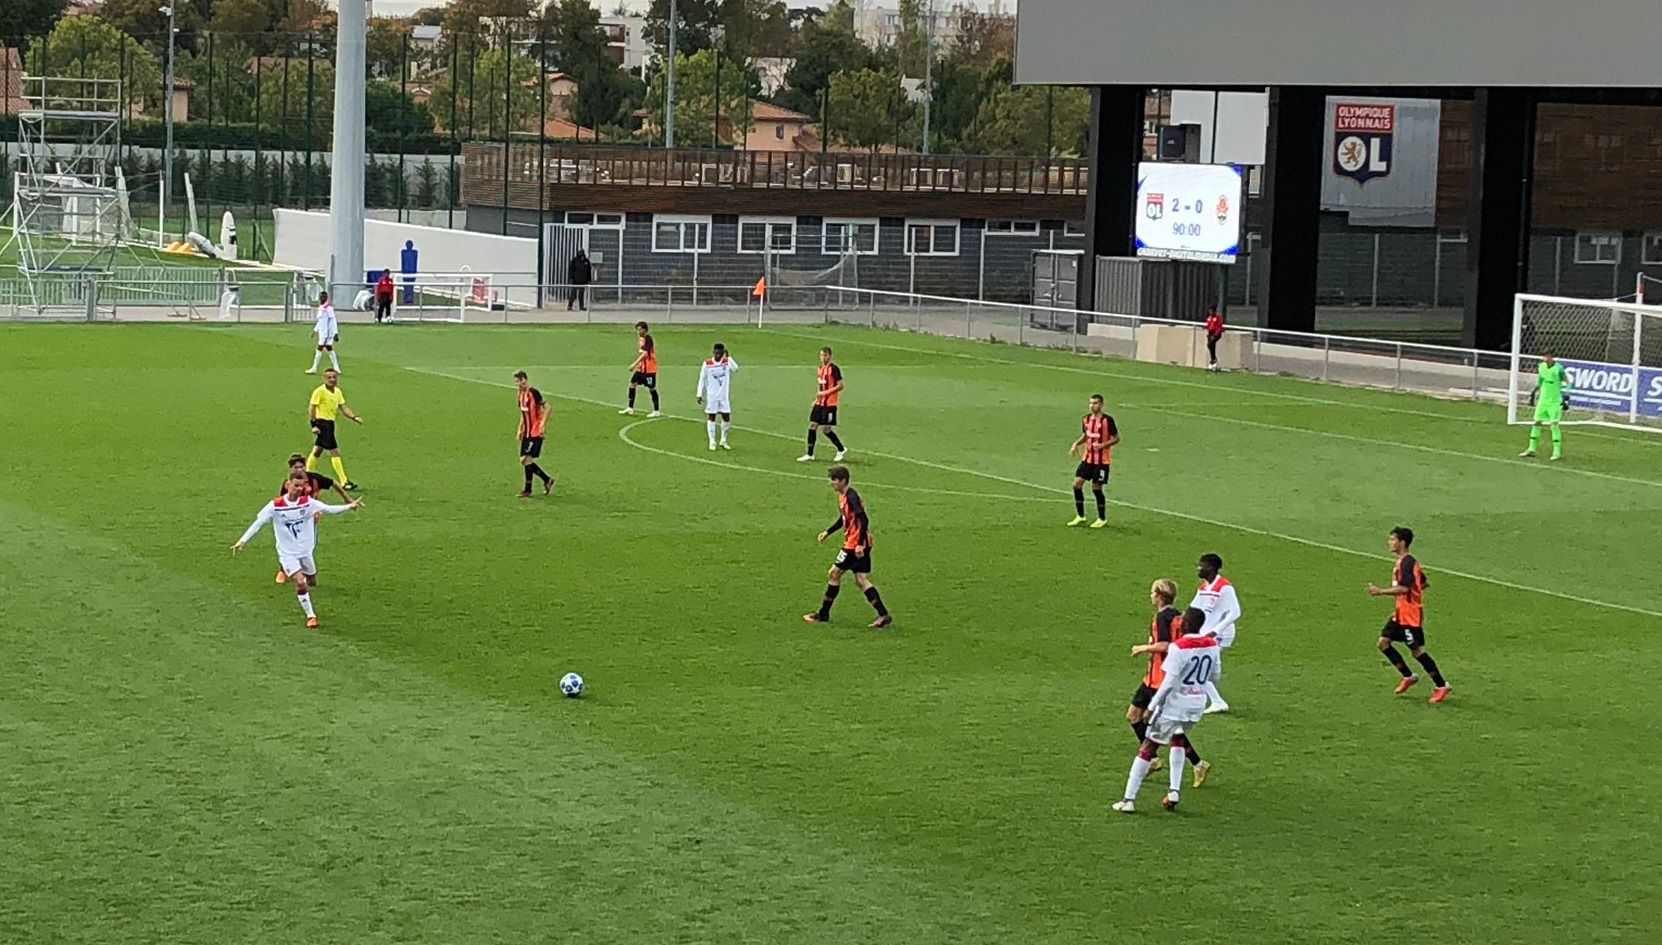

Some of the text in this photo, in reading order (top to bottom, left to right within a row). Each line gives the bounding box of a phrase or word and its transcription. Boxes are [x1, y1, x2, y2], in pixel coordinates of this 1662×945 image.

[1338, 106, 1392, 118] OLYMPIQUE
[1338, 117, 1391, 129] LYONNAIS
[1172, 198, 1180, 212] 2
[1195, 199, 1203, 214] 0
[1172, 222, 1202, 236] 90:00
[1562, 366, 1634, 394] SWORD
[1182, 654, 1213, 686] 20
